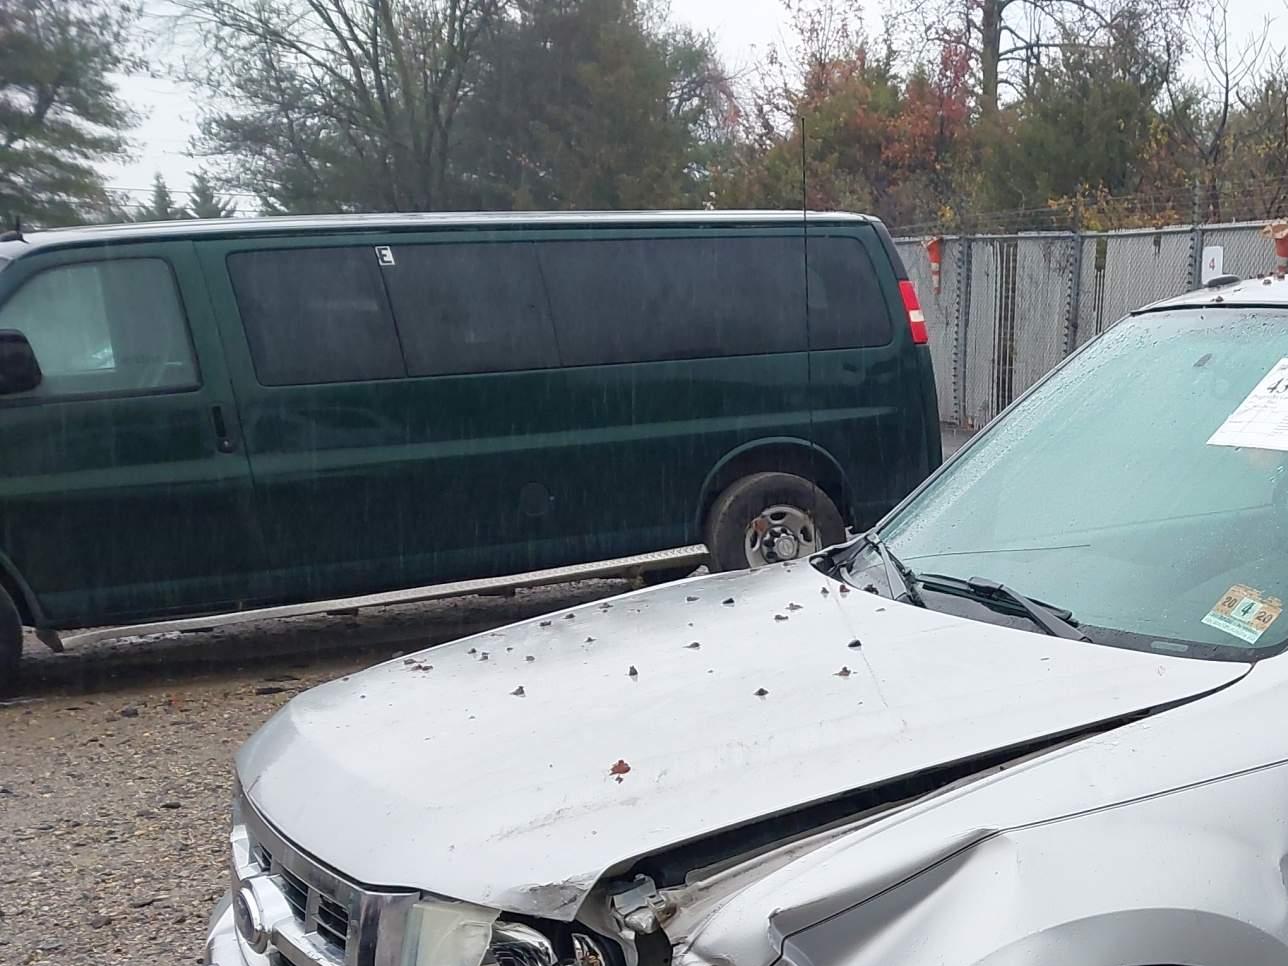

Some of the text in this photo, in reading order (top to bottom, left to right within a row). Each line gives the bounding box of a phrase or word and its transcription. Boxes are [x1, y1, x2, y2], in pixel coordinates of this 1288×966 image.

[1208, 257, 1216, 271] 4
[1222, 596, 1273, 624] 20 4 20
